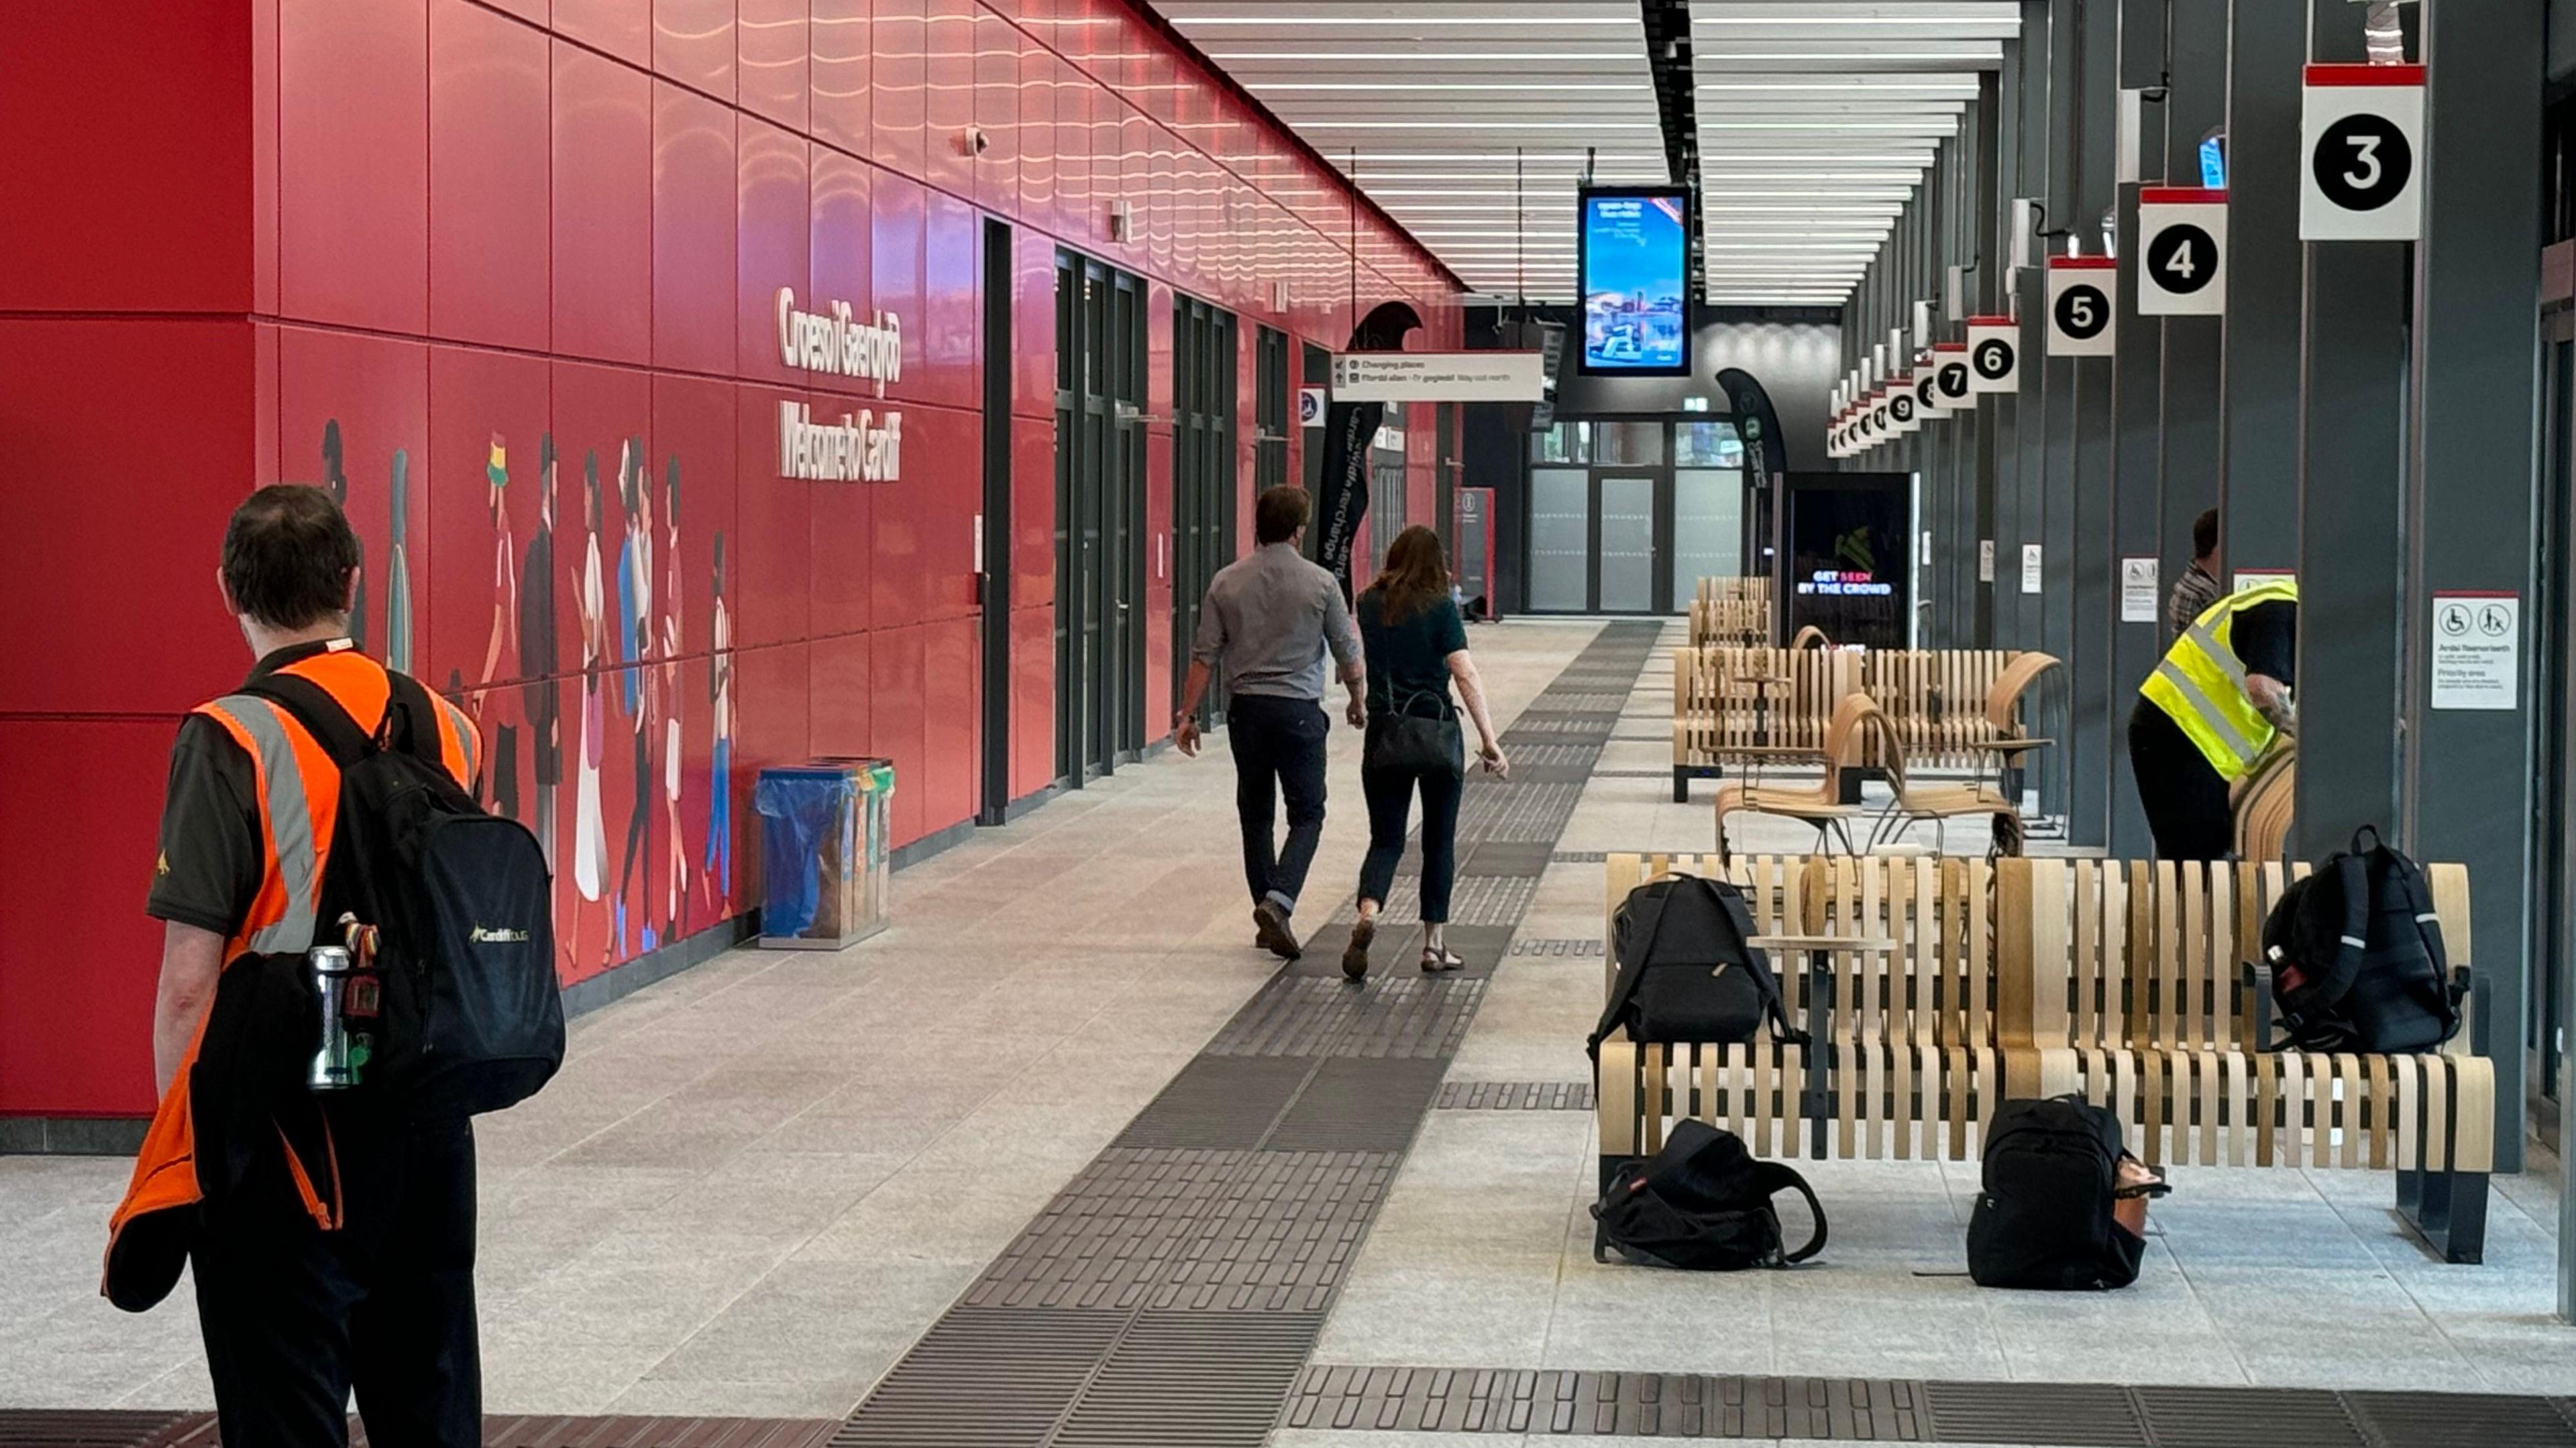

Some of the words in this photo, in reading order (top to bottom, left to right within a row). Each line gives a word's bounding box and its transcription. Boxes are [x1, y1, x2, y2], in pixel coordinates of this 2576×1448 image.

[2343, 135, 2382, 190] 3
[2165, 239, 2195, 279] 4
[2071, 296, 2094, 328] 5
[780, 287, 834, 374] Croeso
[1362, 360, 1398, 370] Changing
[1984, 349, 2002, 372] 6
[1948, 370, 1963, 390] 7
[1926, 383, 1934, 402] 8
[1896, 400, 1910, 416] 9
[780, 400, 847, 482] Welcome
[841, 413, 861, 482] to
[859, 408, 902, 482] Cardiff
[1813, 571, 1839, 581] GET
[1840, 572, 1872, 581] SEEN
[1798, 582, 1815, 594] BY
[1817, 583, 1842, 594] THE
[1842, 583, 1892, 595] CROWD
[2438, 669, 2467, 678] Priority
